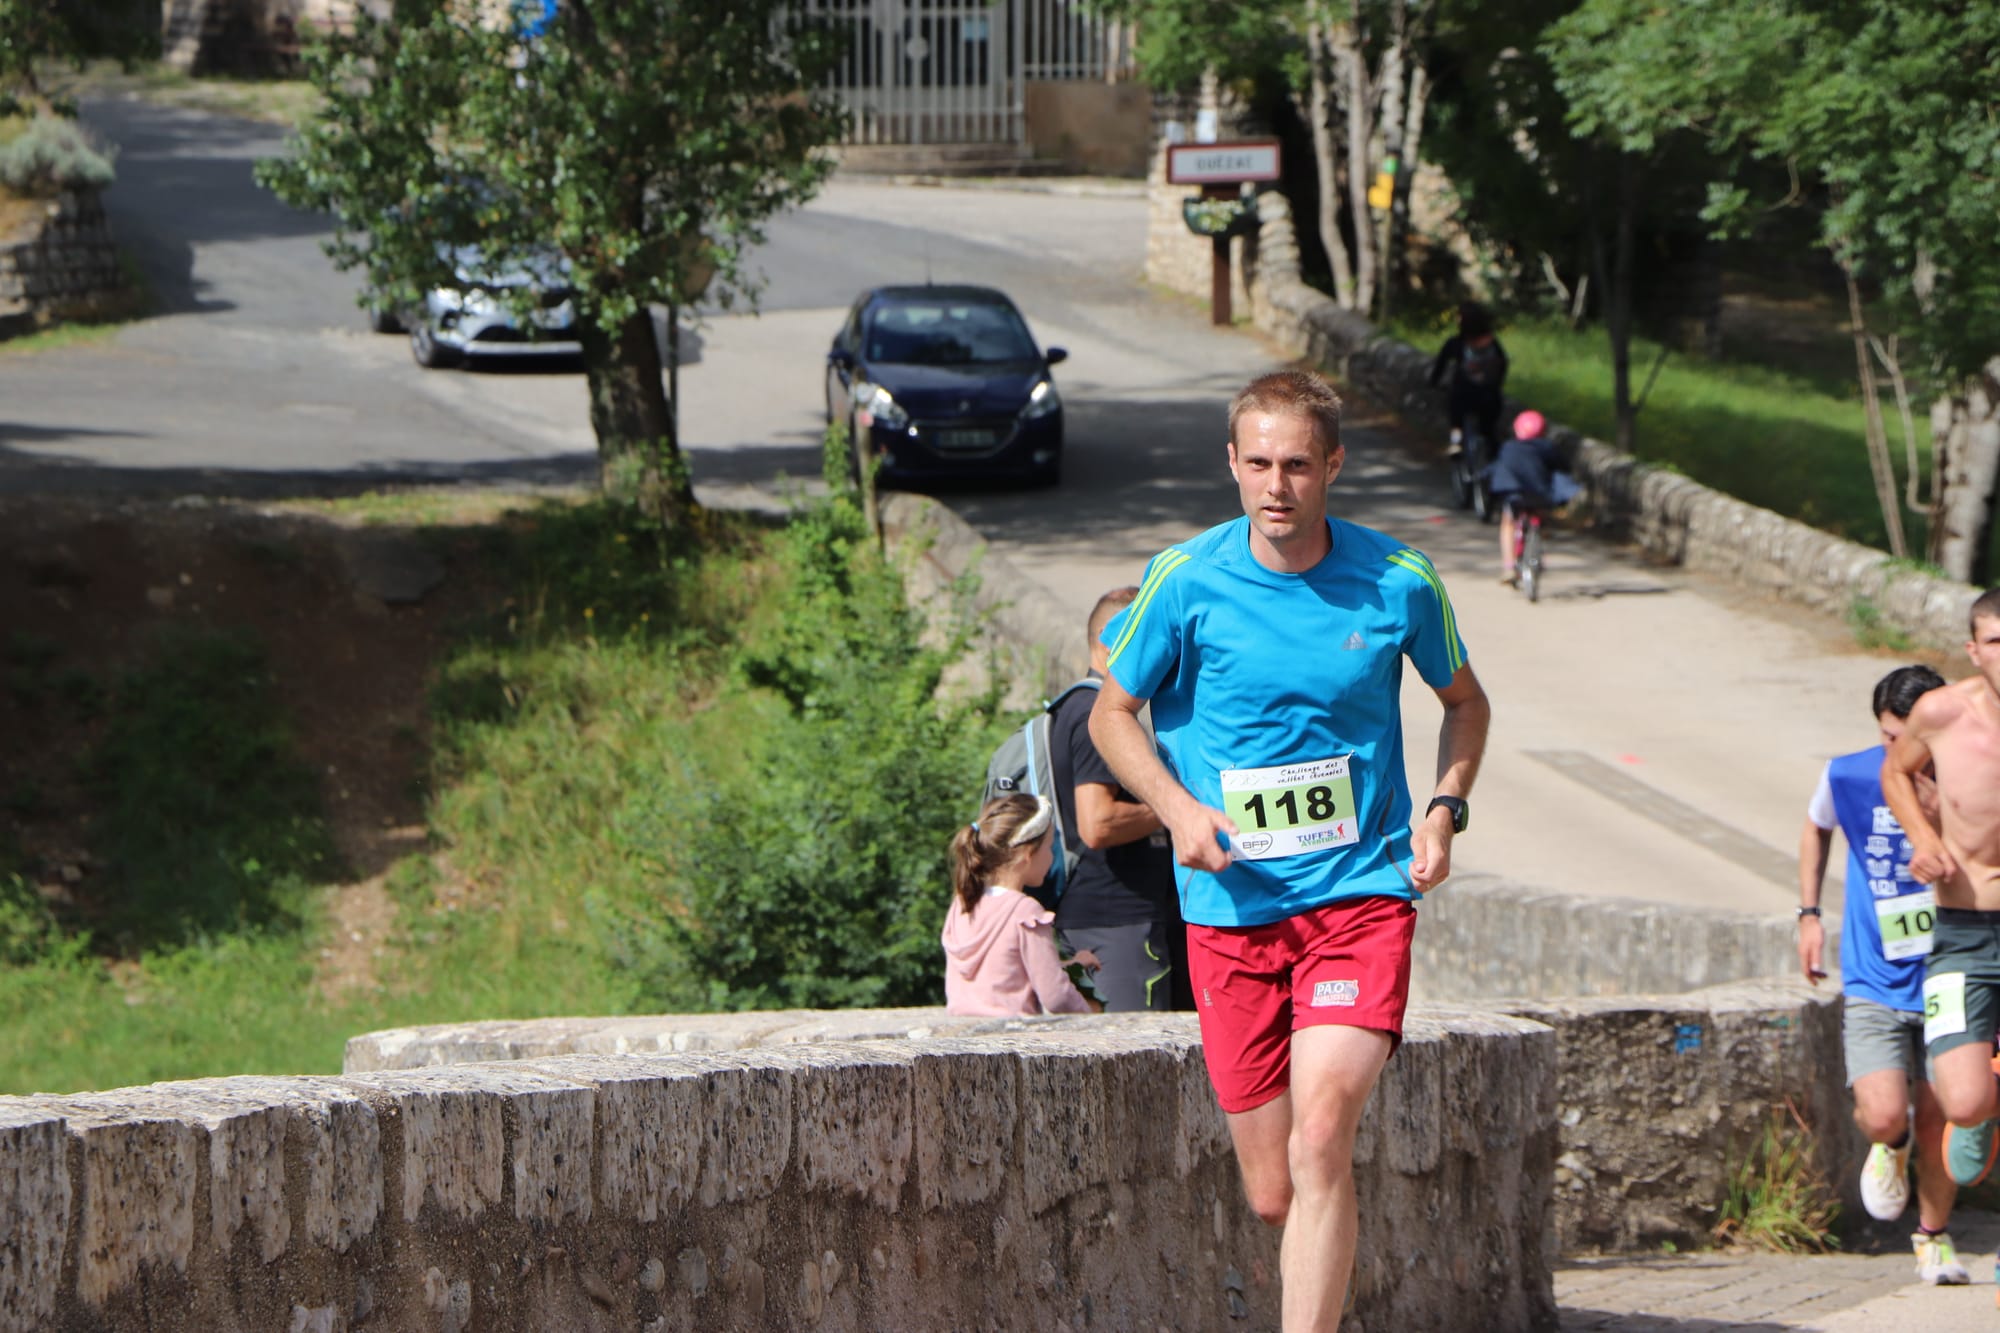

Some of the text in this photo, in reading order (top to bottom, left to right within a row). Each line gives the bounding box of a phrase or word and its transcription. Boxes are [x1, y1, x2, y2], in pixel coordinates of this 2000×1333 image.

[1244, 785, 1336, 829] 118
[1242, 838, 1269, 850] BFP
[1894, 910, 1933, 936] 10
